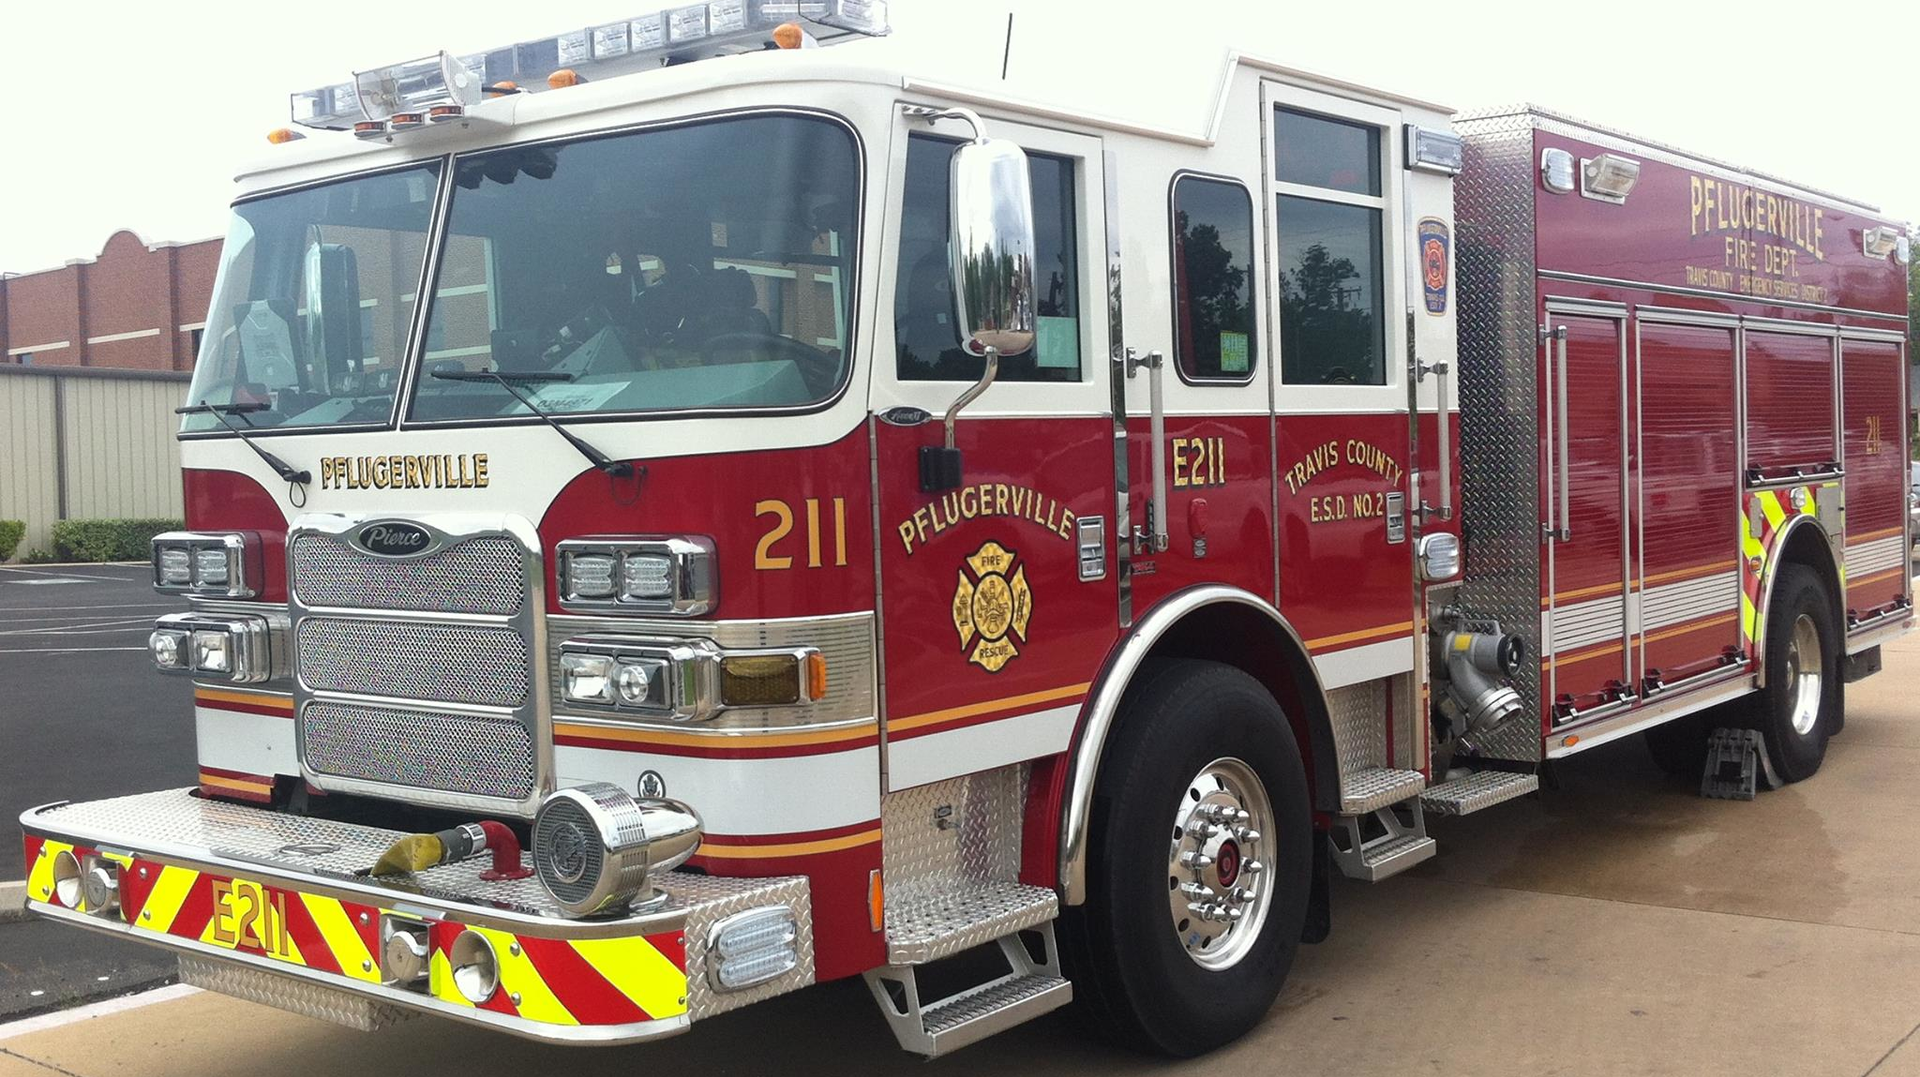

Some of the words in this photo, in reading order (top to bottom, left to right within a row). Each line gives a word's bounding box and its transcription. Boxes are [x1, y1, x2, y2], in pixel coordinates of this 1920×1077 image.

[1690, 175, 1824, 262] PFLUGERVILLE
[1725, 236, 1757, 271] FIRE
[1765, 243, 1799, 277] DEPT.
[1866, 415, 1880, 455] 211
[320, 453, 489, 490] PFLUGERVILLE
[1172, 437, 1226, 488] E211
[1284, 440, 1339, 495] TRAVIS
[1346, 439, 1403, 488] COUNTY
[898, 483, 1075, 555] PFLUGERVILLE
[1310, 495, 1348, 523] E.S.D.
[366, 526, 422, 548] Pierce
[754, 496, 848, 570] 211
[981, 554, 1001, 567] FIRE
[979, 644, 1009, 659] RESCUE
[212, 879, 290, 957] E211
